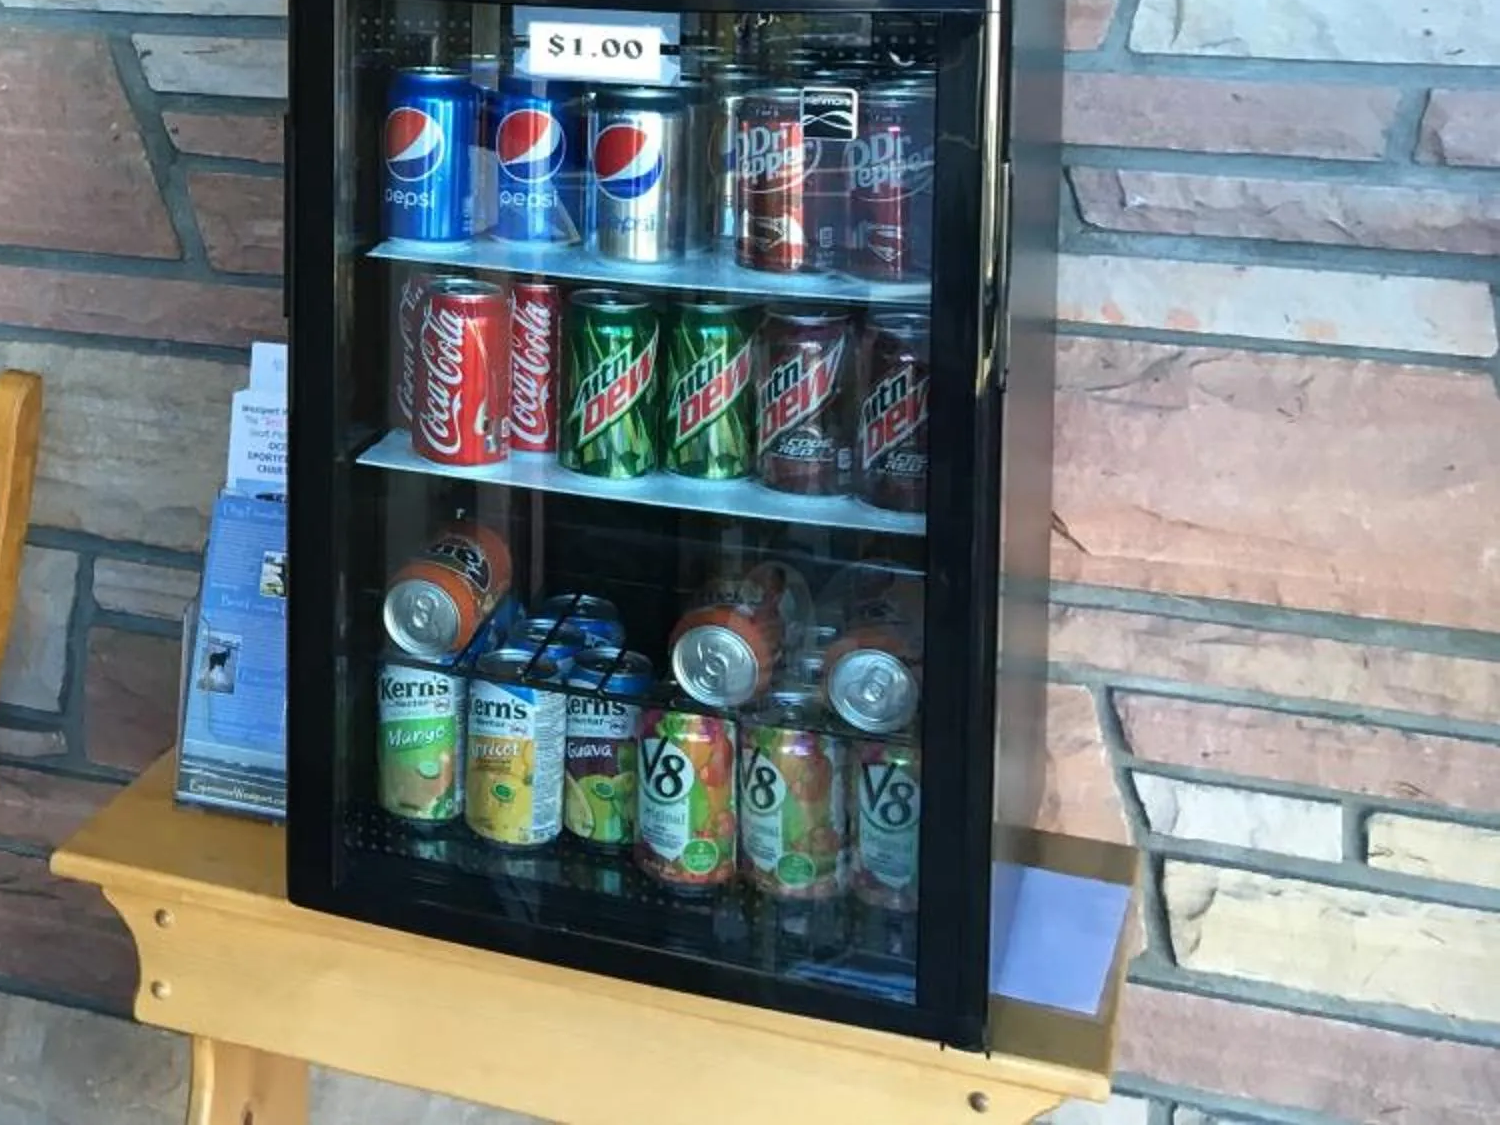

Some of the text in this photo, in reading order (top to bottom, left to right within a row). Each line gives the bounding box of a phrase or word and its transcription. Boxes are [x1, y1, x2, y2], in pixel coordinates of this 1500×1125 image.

[548, 33, 643, 60] $1.00
[500, 190, 558, 211] pepsi
[380, 678, 449, 701] Kern's
[473, 698, 527, 720] ern's
[642, 736, 686, 799] V8
[738, 747, 777, 810] V8
[863, 762, 915, 826] V8
